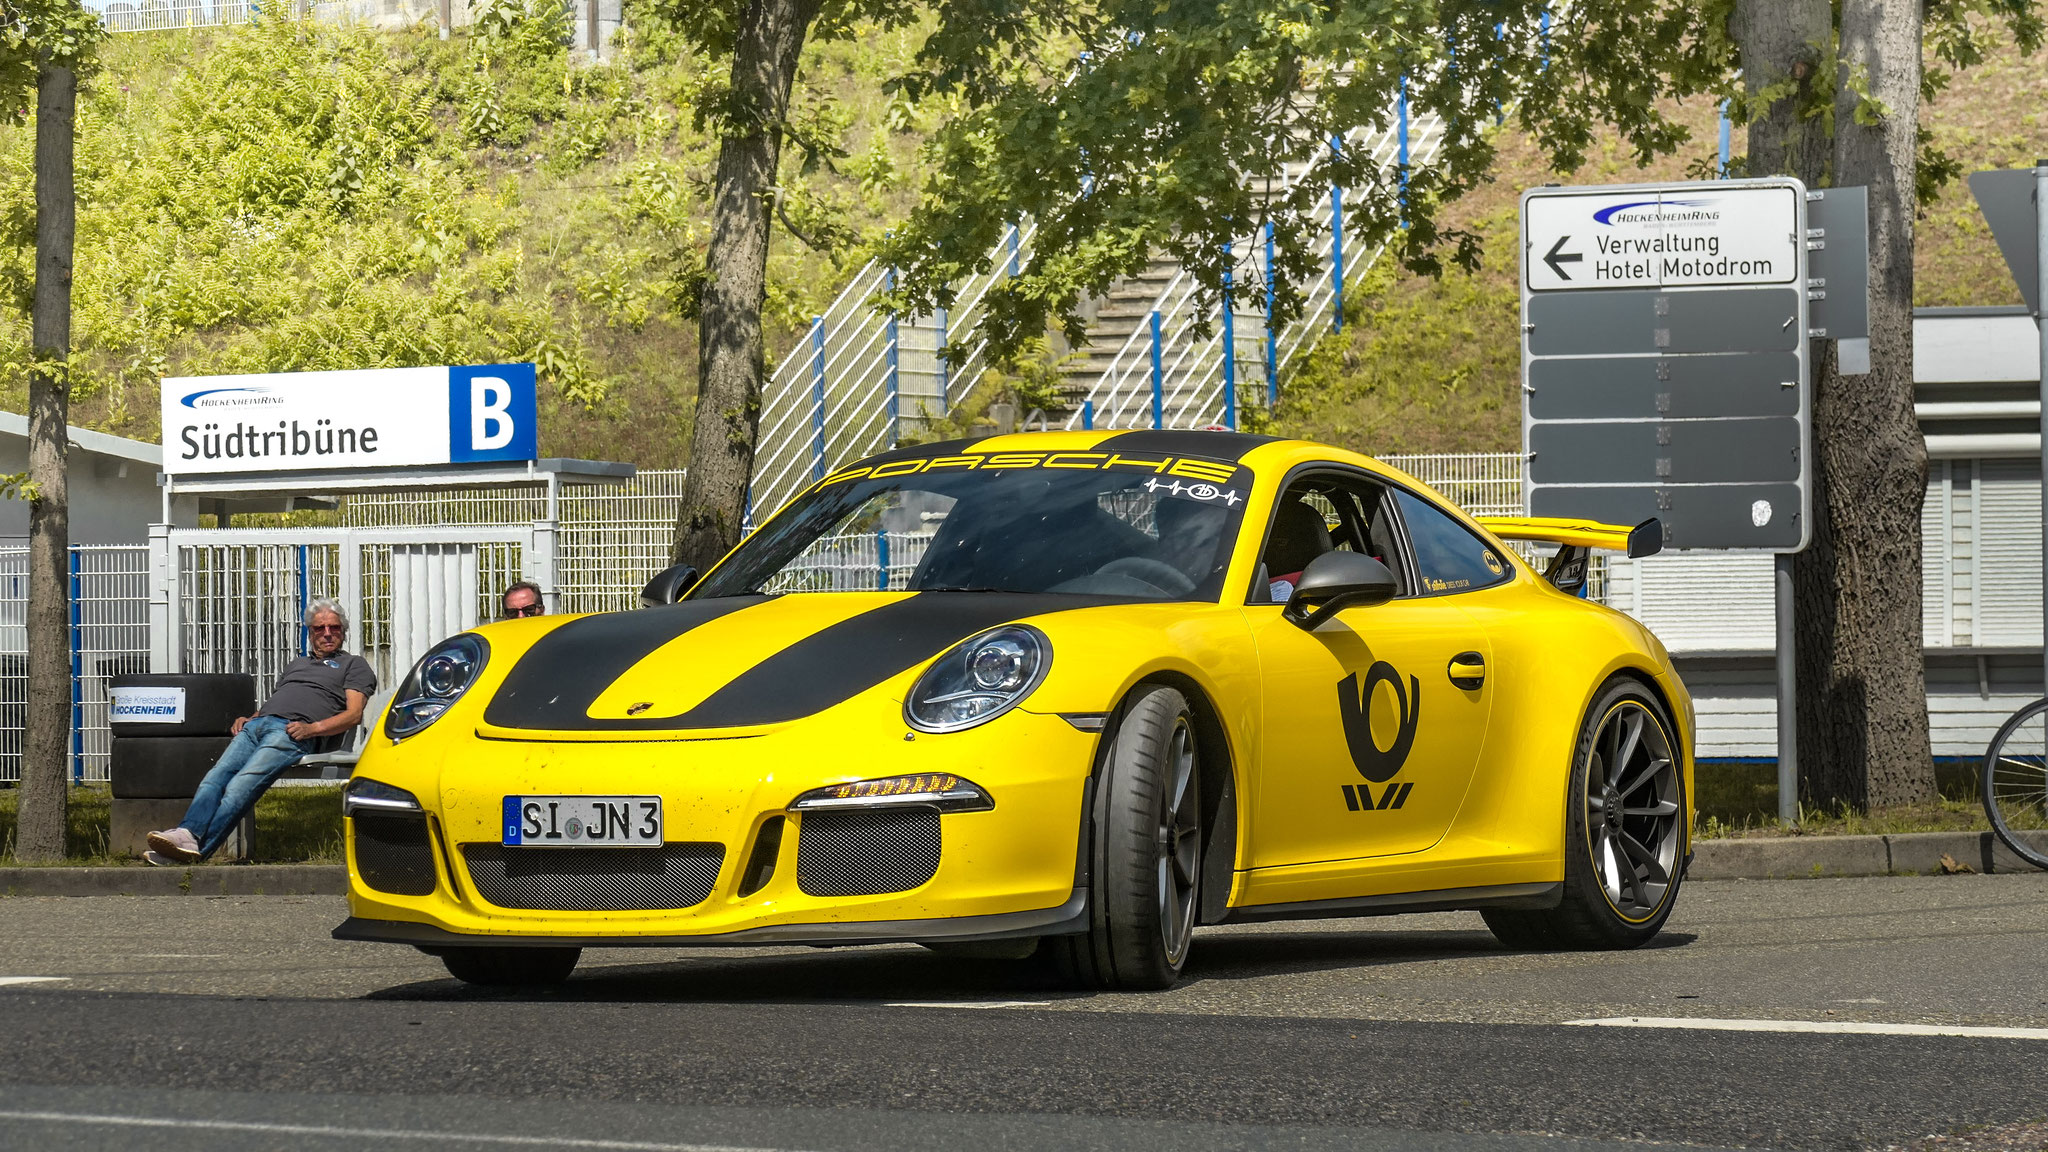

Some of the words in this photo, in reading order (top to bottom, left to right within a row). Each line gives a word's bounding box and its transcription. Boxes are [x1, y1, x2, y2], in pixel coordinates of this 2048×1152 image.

[1596, 233, 1719, 256] Verwaltung
[1596, 259, 1652, 280] Hotel
[1663, 256, 1773, 278] Motodrom
[470, 376, 515, 451] B
[181, 418, 379, 460] Südtribüne
[813, 453, 1238, 484] PORSCHE
[115, 705, 177, 715] HOCKENHEIM
[134, 695, 176, 705] Kreisstadt
[509, 826, 517, 837] D
[522, 802, 562, 839] SI
[586, 802, 630, 839] JN
[638, 802, 659, 839] 3
